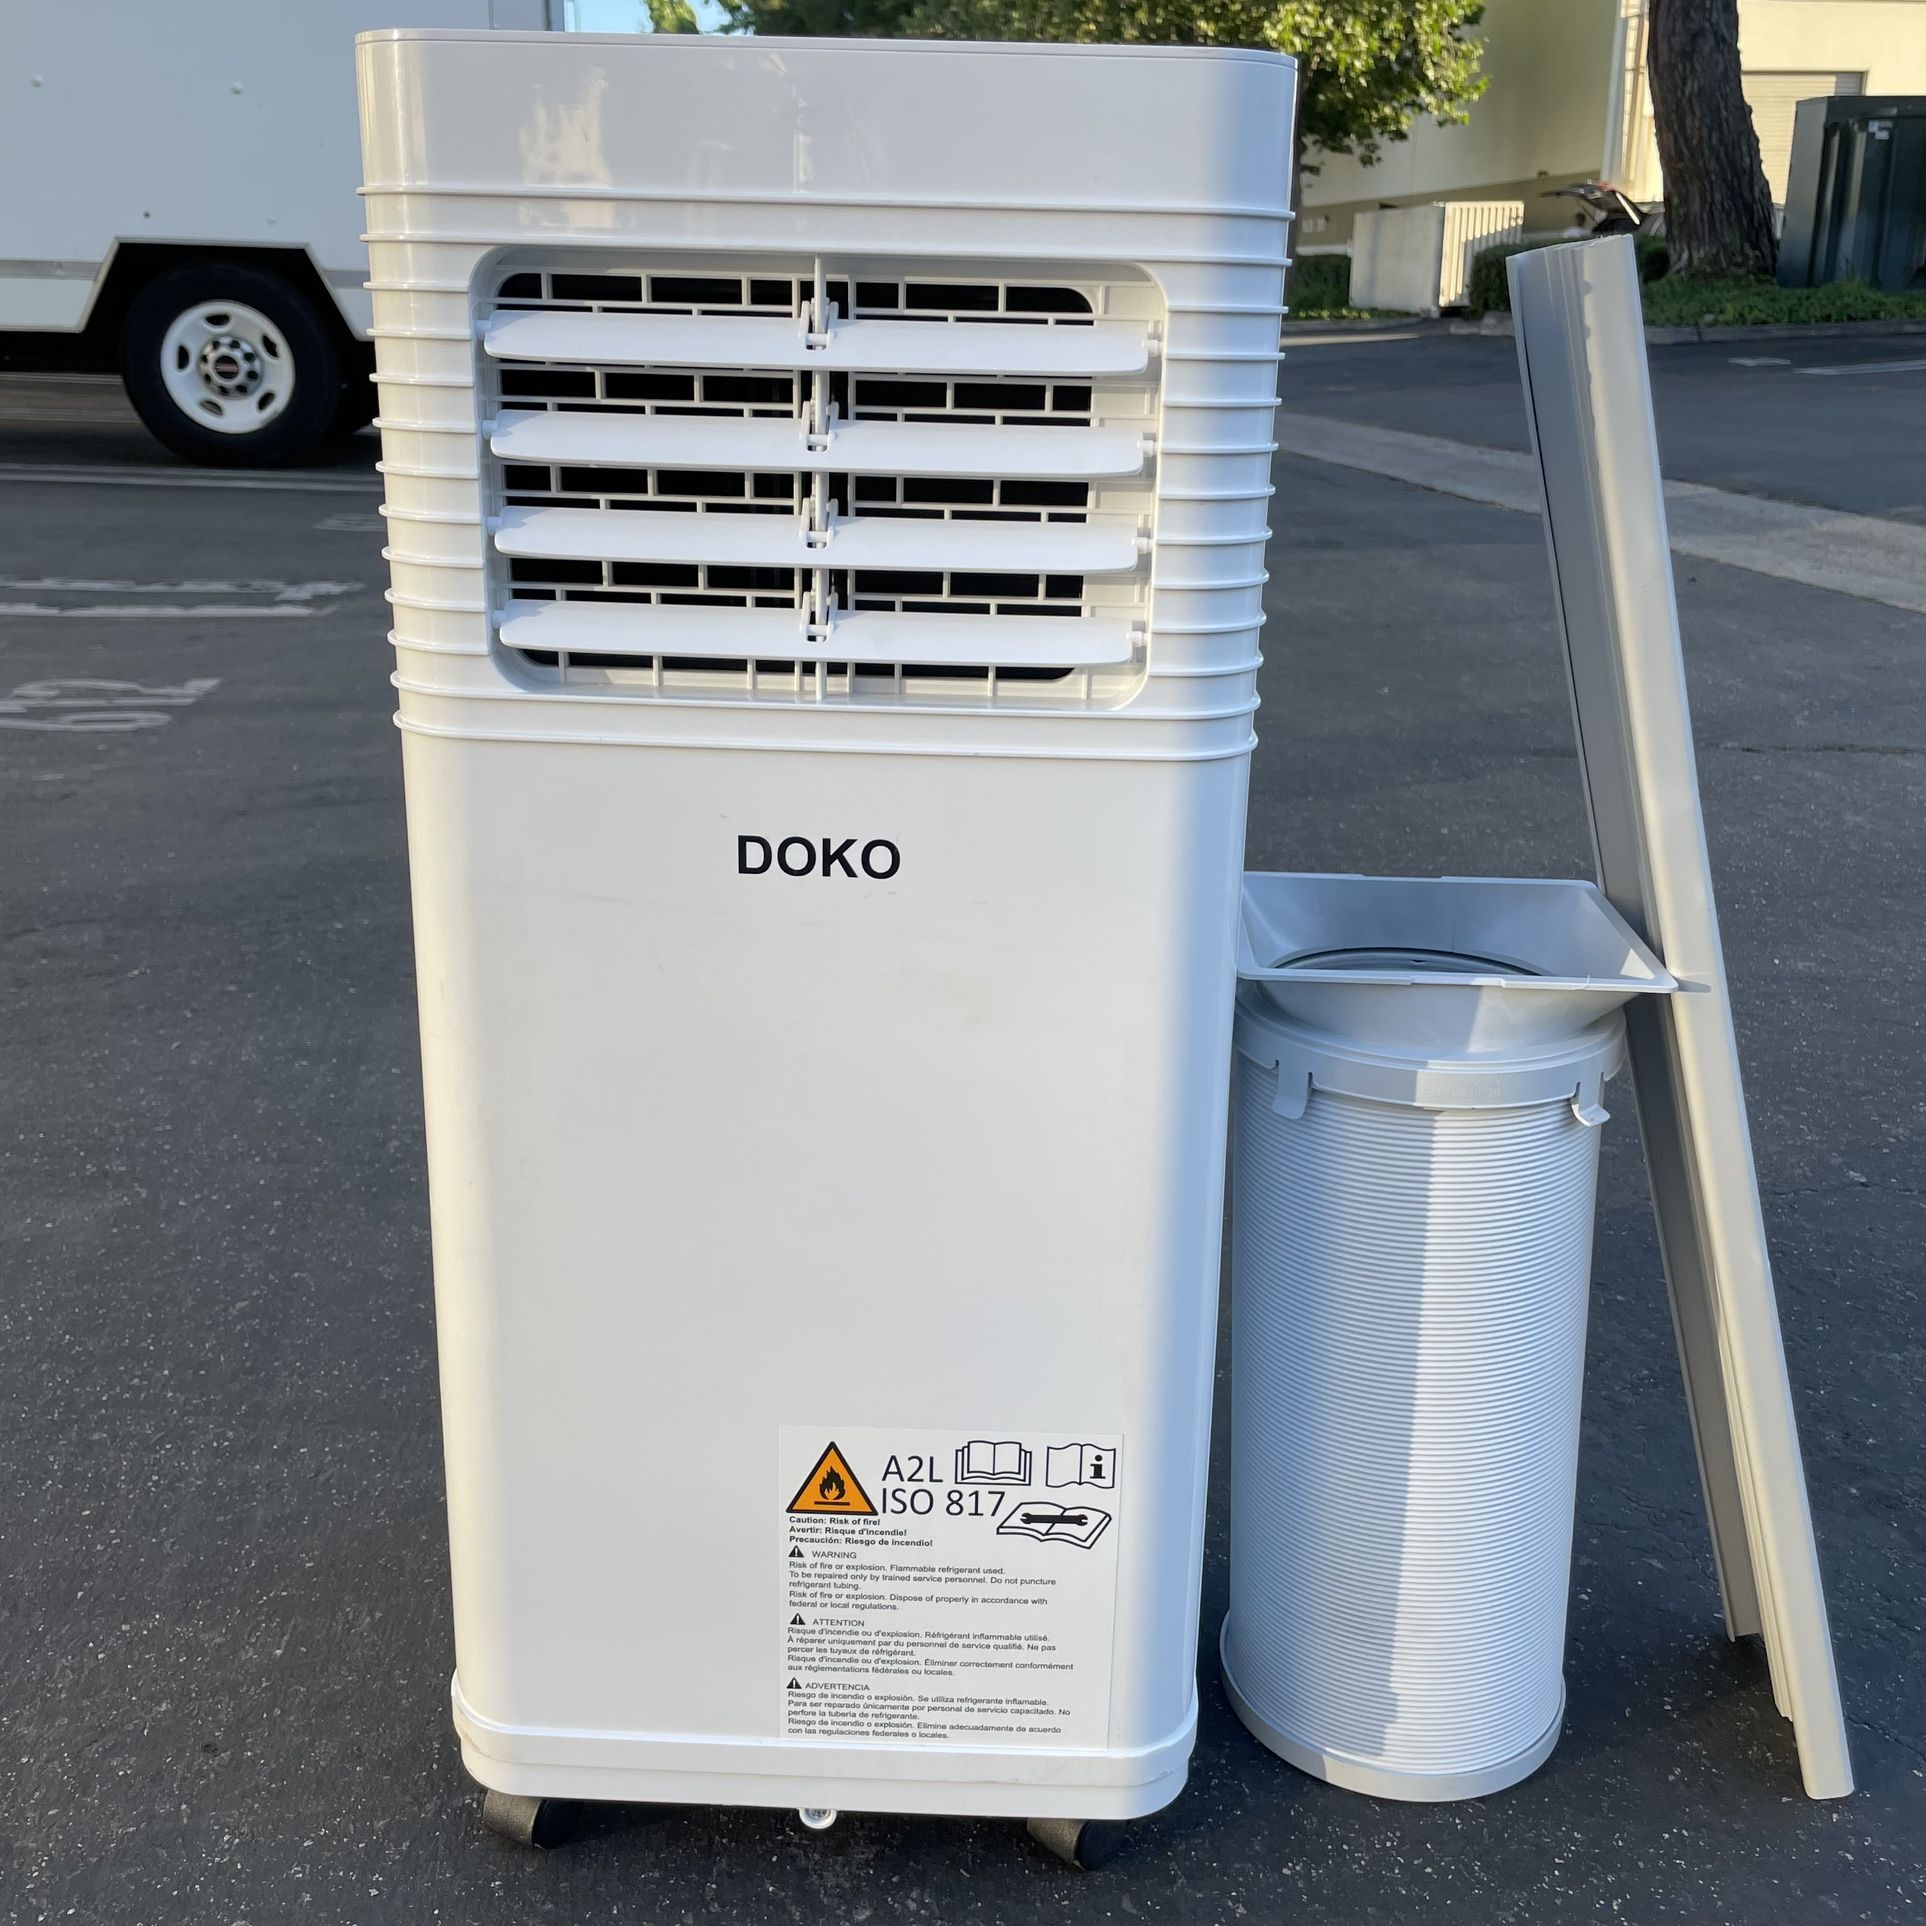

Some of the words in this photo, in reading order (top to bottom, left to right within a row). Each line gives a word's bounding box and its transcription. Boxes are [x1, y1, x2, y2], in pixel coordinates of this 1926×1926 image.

[738, 835, 901, 879] DOKO
[881, 1455, 943, 1482] A2L
[881, 1488, 934, 1515] ISO
[945, 1490, 1006, 1517] 817
[789, 1515, 826, 1524] Caution:
[829, 1517, 849, 1525] Risk
[851, 1517, 861, 1525] of
[862, 1518, 881, 1526] fire!
[789, 1525, 822, 1534] Avertir:
[825, 1527, 856, 1537] Risque
[844, 1537, 876, 1547] Riesgo
[878, 1538, 890, 1546] de
[891, 1539, 933, 1547] incendio!
[811, 1550, 857, 1559] WARNING
[789, 1561, 807, 1569] Risk
[809, 1561, 818, 1569] of
[819, 1562, 833, 1570] fire
[845, 1563, 887, 1573] explosion.
[890, 1564, 936, 1573] Flammable
[938, 1566, 981, 1576] refrigerant
[982, 1567, 1006, 1575] used.
[789, 1580, 831, 1591] refrigerant
[833, 1581, 861, 1592] tubing.
[801, 1571, 812, 1579] be
[814, 1571, 848, 1582] repaired
[850, 1572, 867, 1583] only
[870, 1573, 880, 1583] by
[882, 1573, 911, 1582] trained
[912, 1574, 942, 1583] service
[944, 1575, 988, 1586] personnel.
[990, 1577, 1002, 1585] Do
[1004, 1577, 1018, 1585] not
[1019, 1578, 1056, 1589] puncture
[789, 1590, 807, 1598] Risk
[819, 1591, 833, 1599] fire
[845, 1592, 887, 1602] explosion.
[889, 1593, 923, 1604] Dispose
[925, 1594, 934, 1602] of
[935, 1595, 969, 1605] properly
[980, 1596, 1029, 1605] accordance
[1030, 1598, 1048, 1606] with
[789, 1600, 818, 1608] federal
[830, 1601, 850, 1609] local
[851, 1602, 899, 1613] regulations.
[812, 1618, 865, 1627] ATTENTION
[787, 1626, 816, 1637] Risque
[972, 1632, 1022, 1641] inflammable
[787, 1646, 813, 1655] percer
[815, 1646, 828, 1654] les
[829, 1647, 857, 1657] tuyaux
[859, 1647, 870, 1655] de
[828, 1637, 876, 1648] uniquement
[878, 1640, 892, 1649] par
[906, 1640, 947, 1651] personnel
[949, 1641, 960, 1649] de
[961, 1642, 991, 1650] service
[1027, 1644, 1039, 1652] Ne
[1041, 1646, 1057, 1654] pas
[787, 1654, 816, 1664] Risque
[959, 1660, 1013, 1668] correctement
[924, 1668, 955, 1676] locales.
[805, 1682, 871, 1691] ADVERTENCIA
[787, 1691, 816, 1701] Riesgo
[830, 1692, 865, 1700] incendio
[931, 1695, 955, 1703] utiliza
[956, 1696, 1003, 1707] refrigerante
[1005, 1698, 1050, 1706] inflamable.
[787, 1709, 817, 1719] perfore
[858, 1711, 869, 1719] de
[871, 1712, 920, 1722] refrigerante.
[824, 1701, 861, 1711] reparado
[912, 1705, 926, 1713] por
[927, 1704, 963, 1714] personal
[964, 1705, 975, 1713] de
[977, 1706, 1008, 1714] servicio
[1010, 1707, 1056, 1717] capacitado.
[1058, 1708, 1071, 1716] No
[787, 1718, 816, 1728] Riesgo
[830, 1719, 865, 1727] incendio
[917, 1722, 947, 1730] Elimine
[949, 1723, 1014, 1732] adecuadamente
[1028, 1725, 1062, 1734] acuerdo
[804, 1727, 816, 1735] las
[818, 1728, 870, 1739] regulaciones
[872, 1730, 909, 1738] federales
[918, 1731, 950, 1739] locales.
